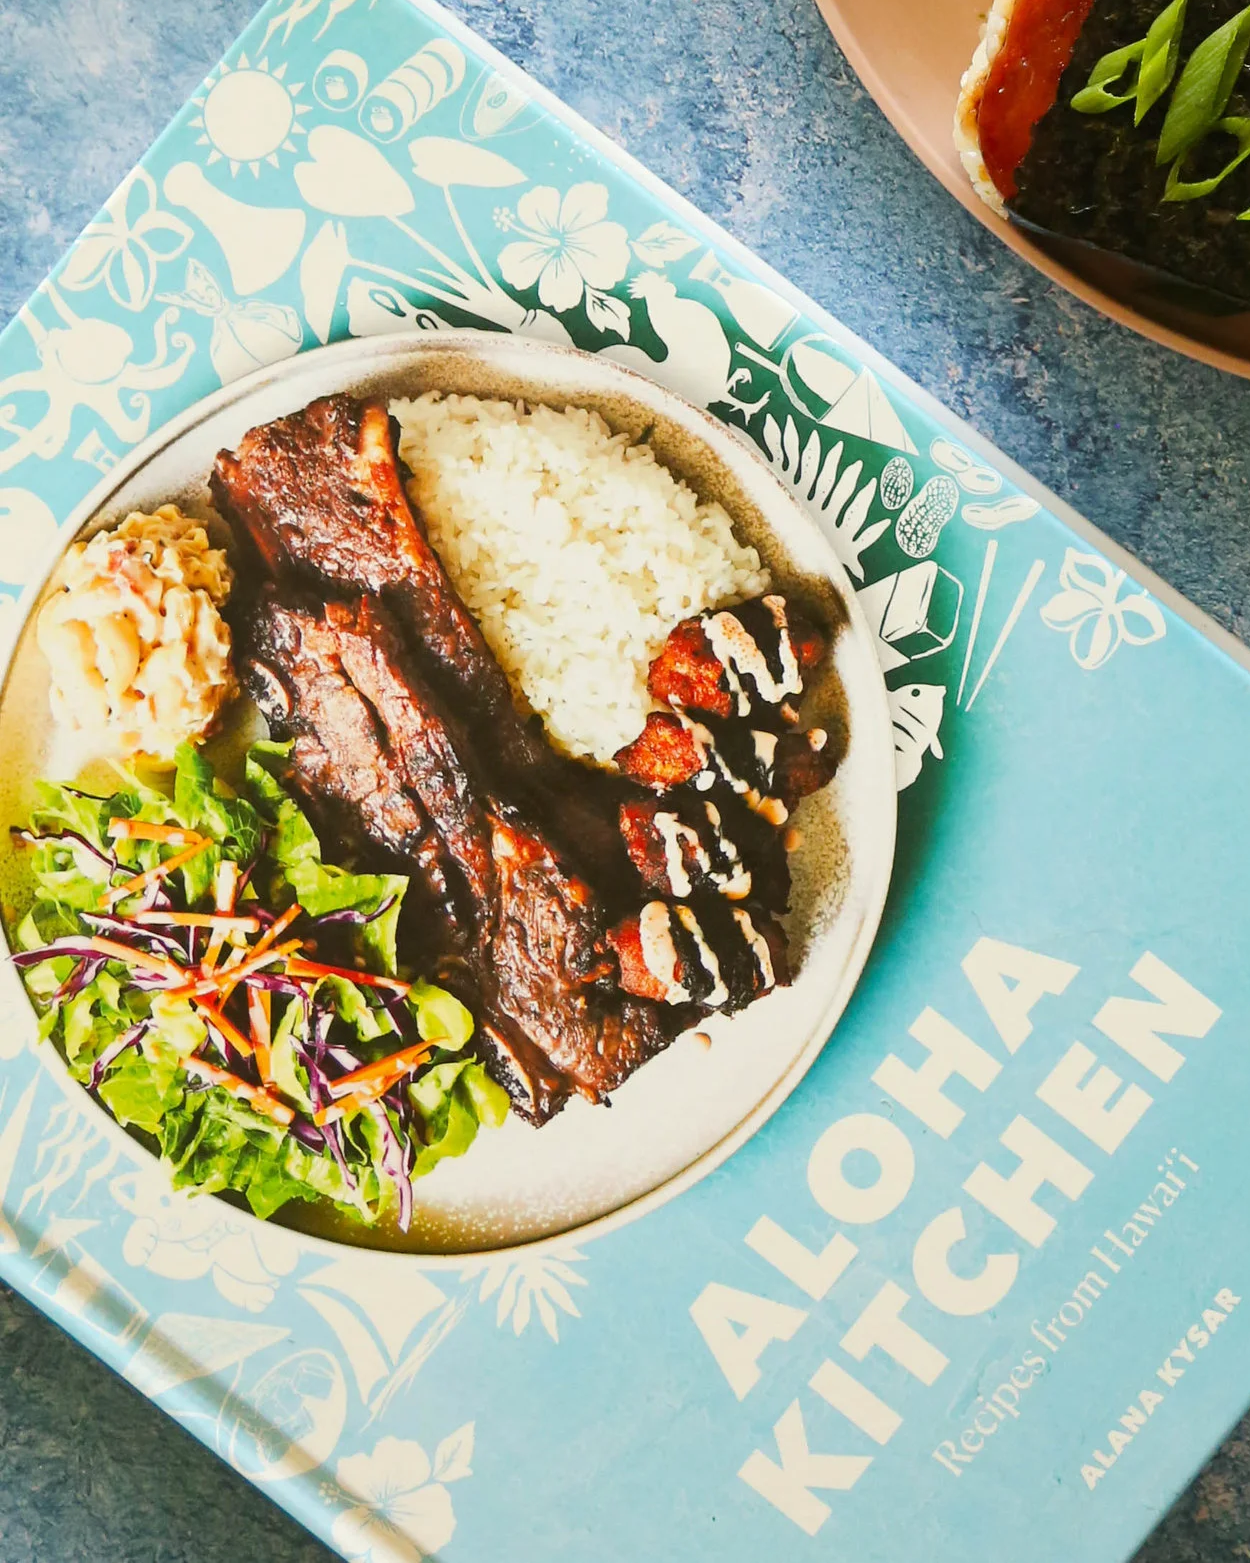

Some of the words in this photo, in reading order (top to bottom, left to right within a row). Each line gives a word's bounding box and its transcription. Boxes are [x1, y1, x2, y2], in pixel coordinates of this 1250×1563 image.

[688, 937, 1081, 1401] ALOHA
[736, 951, 1222, 1536] KITCHEN
[932, 1350, 1046, 1477] Recipes
[1030, 1270, 1110, 1352] from
[1080, 1389, 1164, 1490] ALANA
[1157, 1288, 1241, 1388] KYSAR
